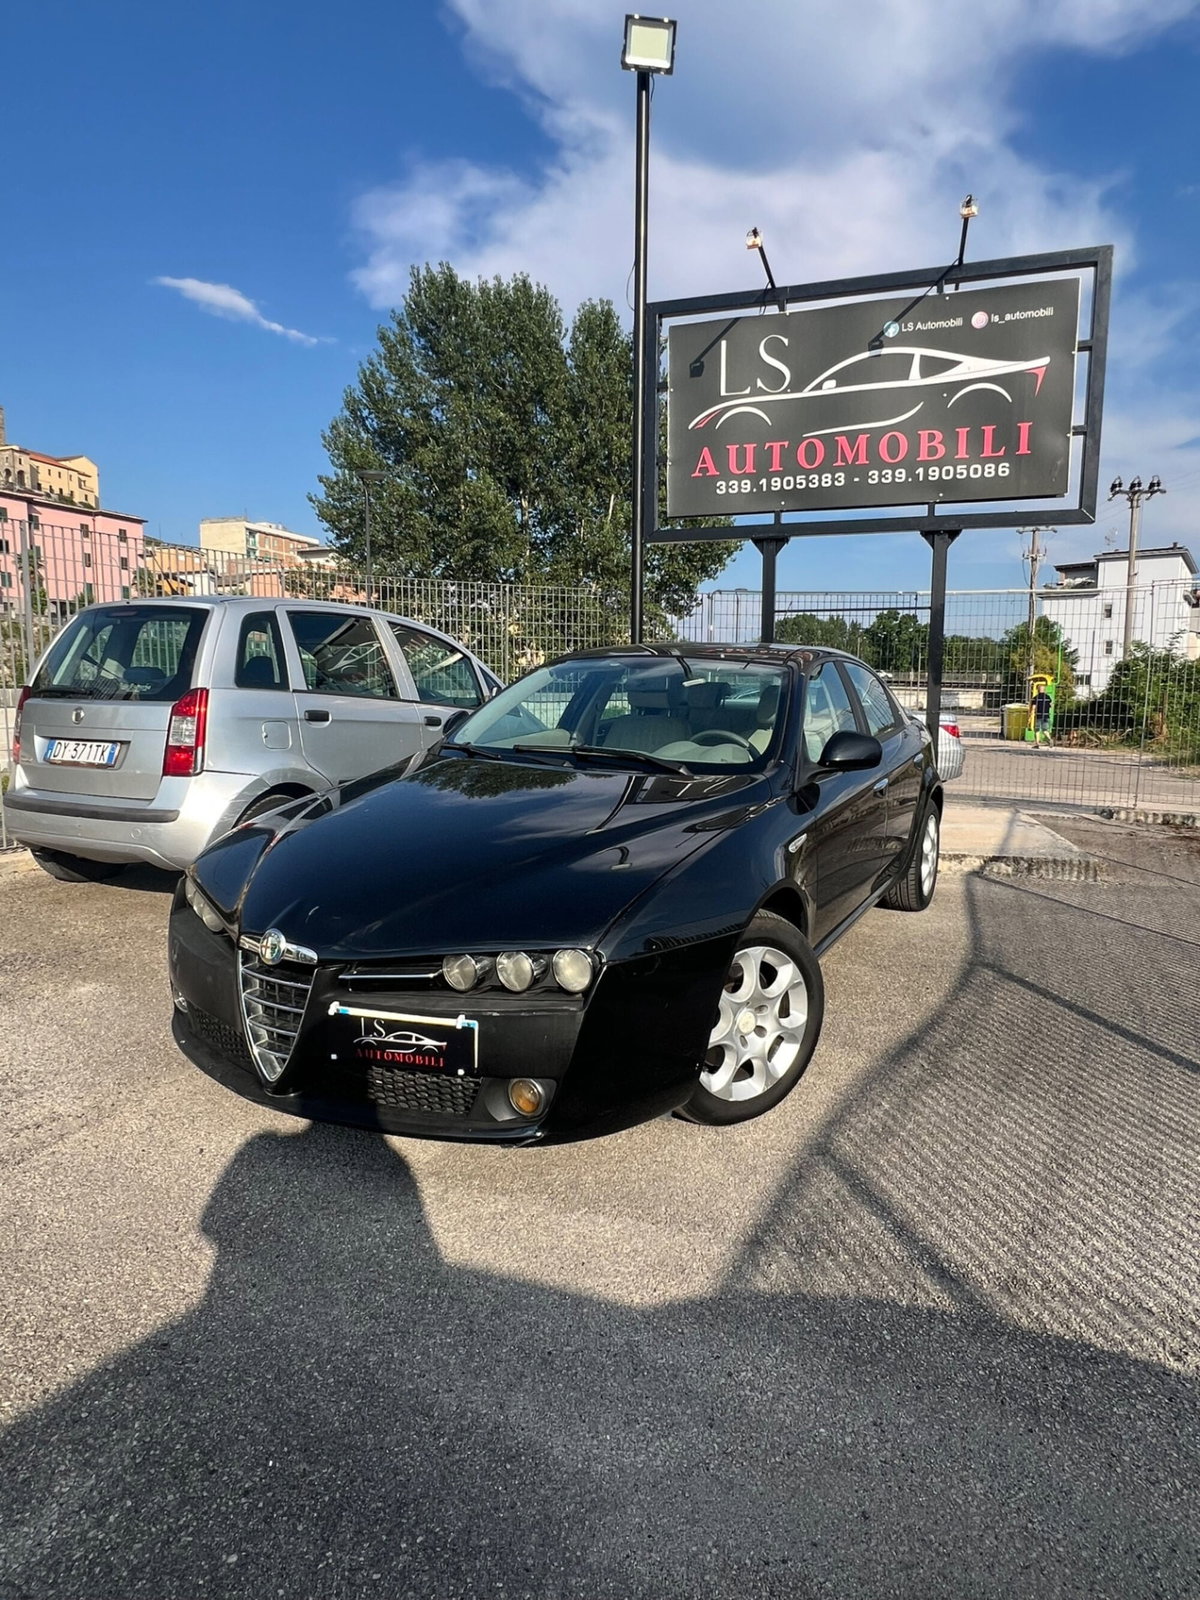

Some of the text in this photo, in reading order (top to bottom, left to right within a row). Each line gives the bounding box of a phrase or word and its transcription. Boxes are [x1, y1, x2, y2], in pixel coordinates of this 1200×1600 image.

[901, 316, 963, 332] LS Automobili
[990, 306, 1054, 324] ls_automobili
[720, 334, 791, 397] LS
[690, 421, 1033, 478] AUTOMOBILI
[716, 472, 845, 495] 339.1905383
[867, 463, 1010, 484] 339.1905086
[356, 1048, 445, 1067] AUTOMOBILI
